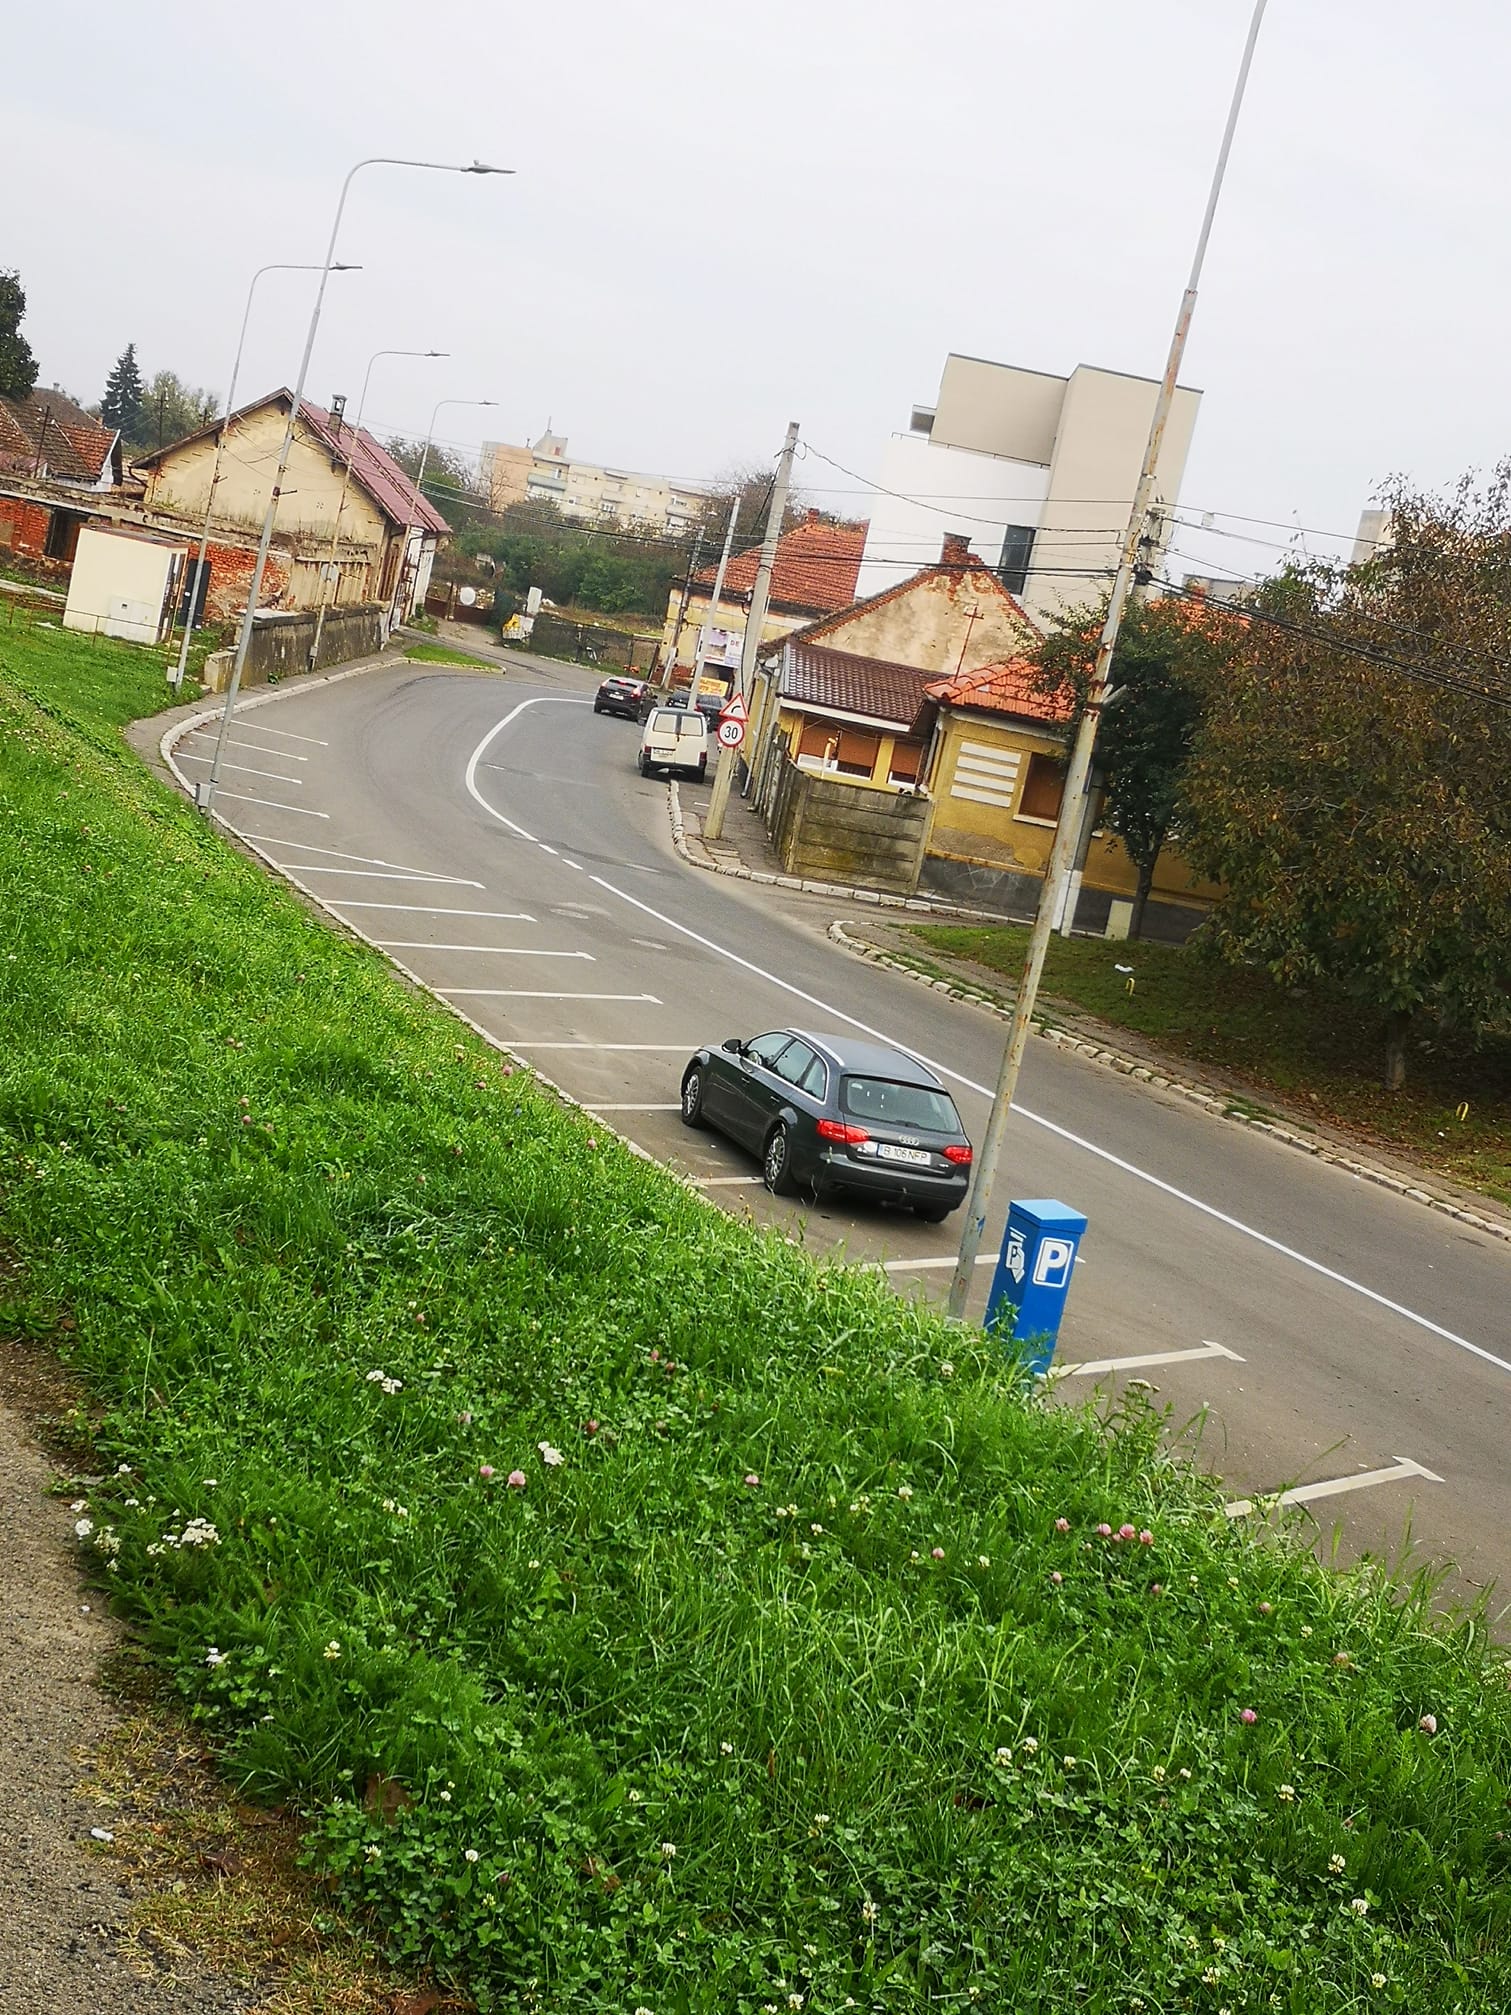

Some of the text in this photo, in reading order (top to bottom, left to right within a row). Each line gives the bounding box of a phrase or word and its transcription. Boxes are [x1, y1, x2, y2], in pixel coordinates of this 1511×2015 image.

[724, 725, 739, 740] 30
[894, 1148, 907, 1158] 106
[908, 1150, 928, 1160] NFP
[1036, 1240, 1068, 1282] P
